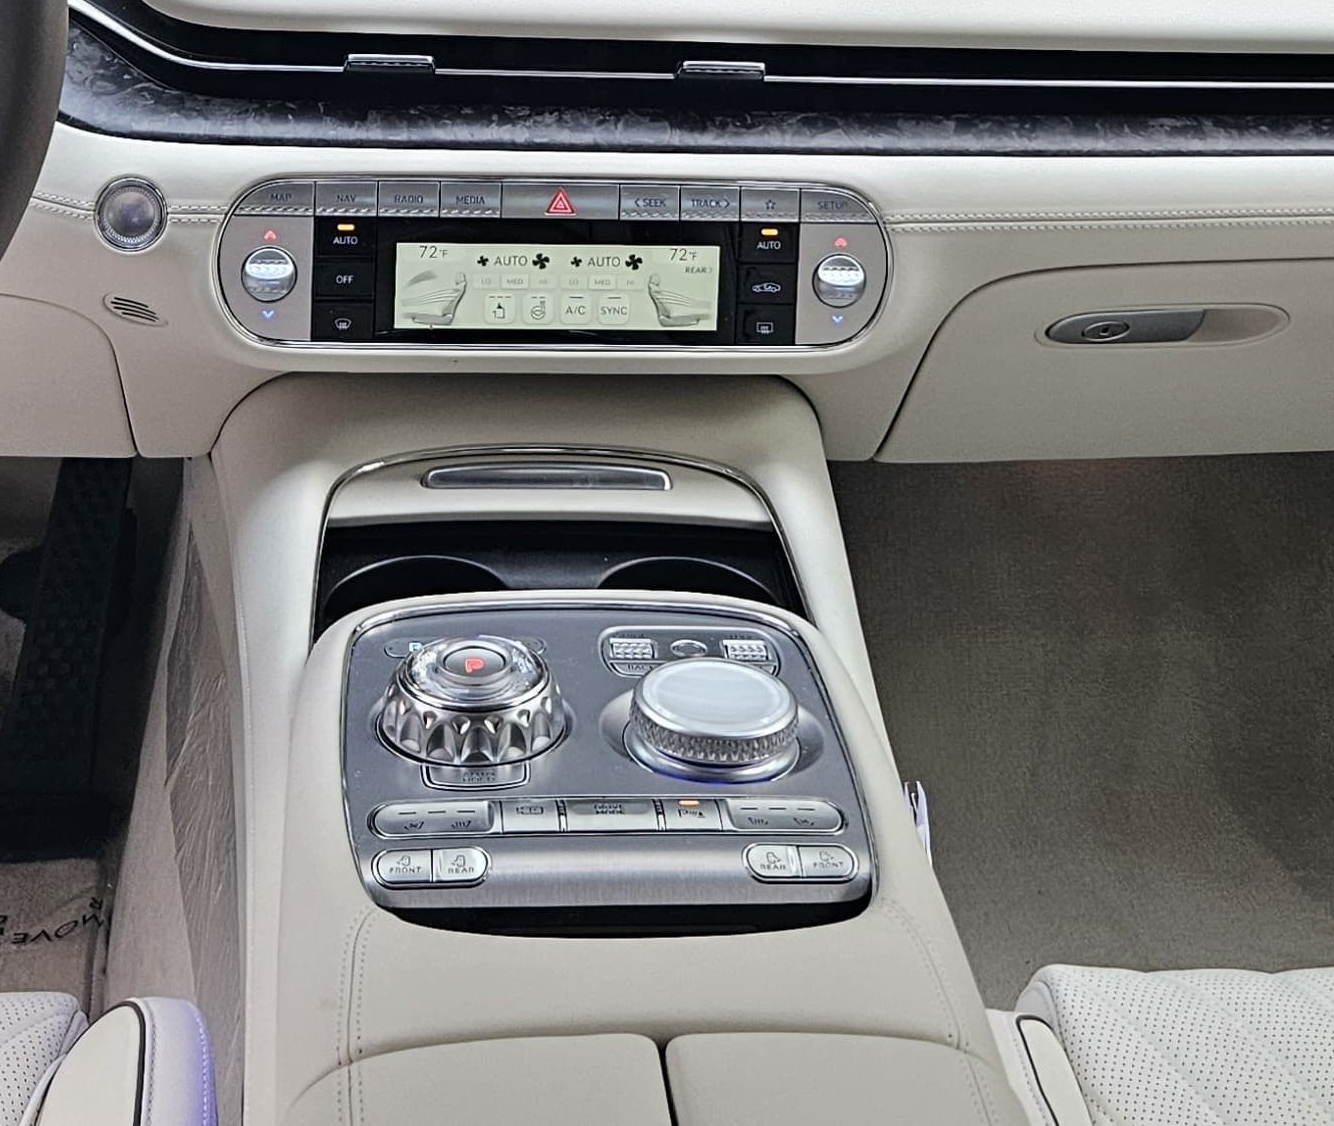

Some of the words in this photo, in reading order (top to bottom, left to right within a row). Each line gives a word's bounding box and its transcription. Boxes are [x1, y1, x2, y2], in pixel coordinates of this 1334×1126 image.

[270, 193, 292, 203] MAP
[337, 194, 356, 204] NAV
[394, 194, 424, 204] RADIO
[456, 195, 485, 205] MEDIA
[642, 198, 666, 207] SEEK
[691, 199, 722, 208] TRACK
[333, 236, 358, 246] AUTO
[757, 241, 781, 250] AUTO
[494, 256, 528, 268] AUTO
[587, 256, 621, 268] AUTO
[685, 266, 707, 275] REAR
[336, 275, 354, 284] OFF
[565, 305, 586, 316] A/C
[600, 305, 628, 316] SYNC
[465, 658, 484, 673] P
